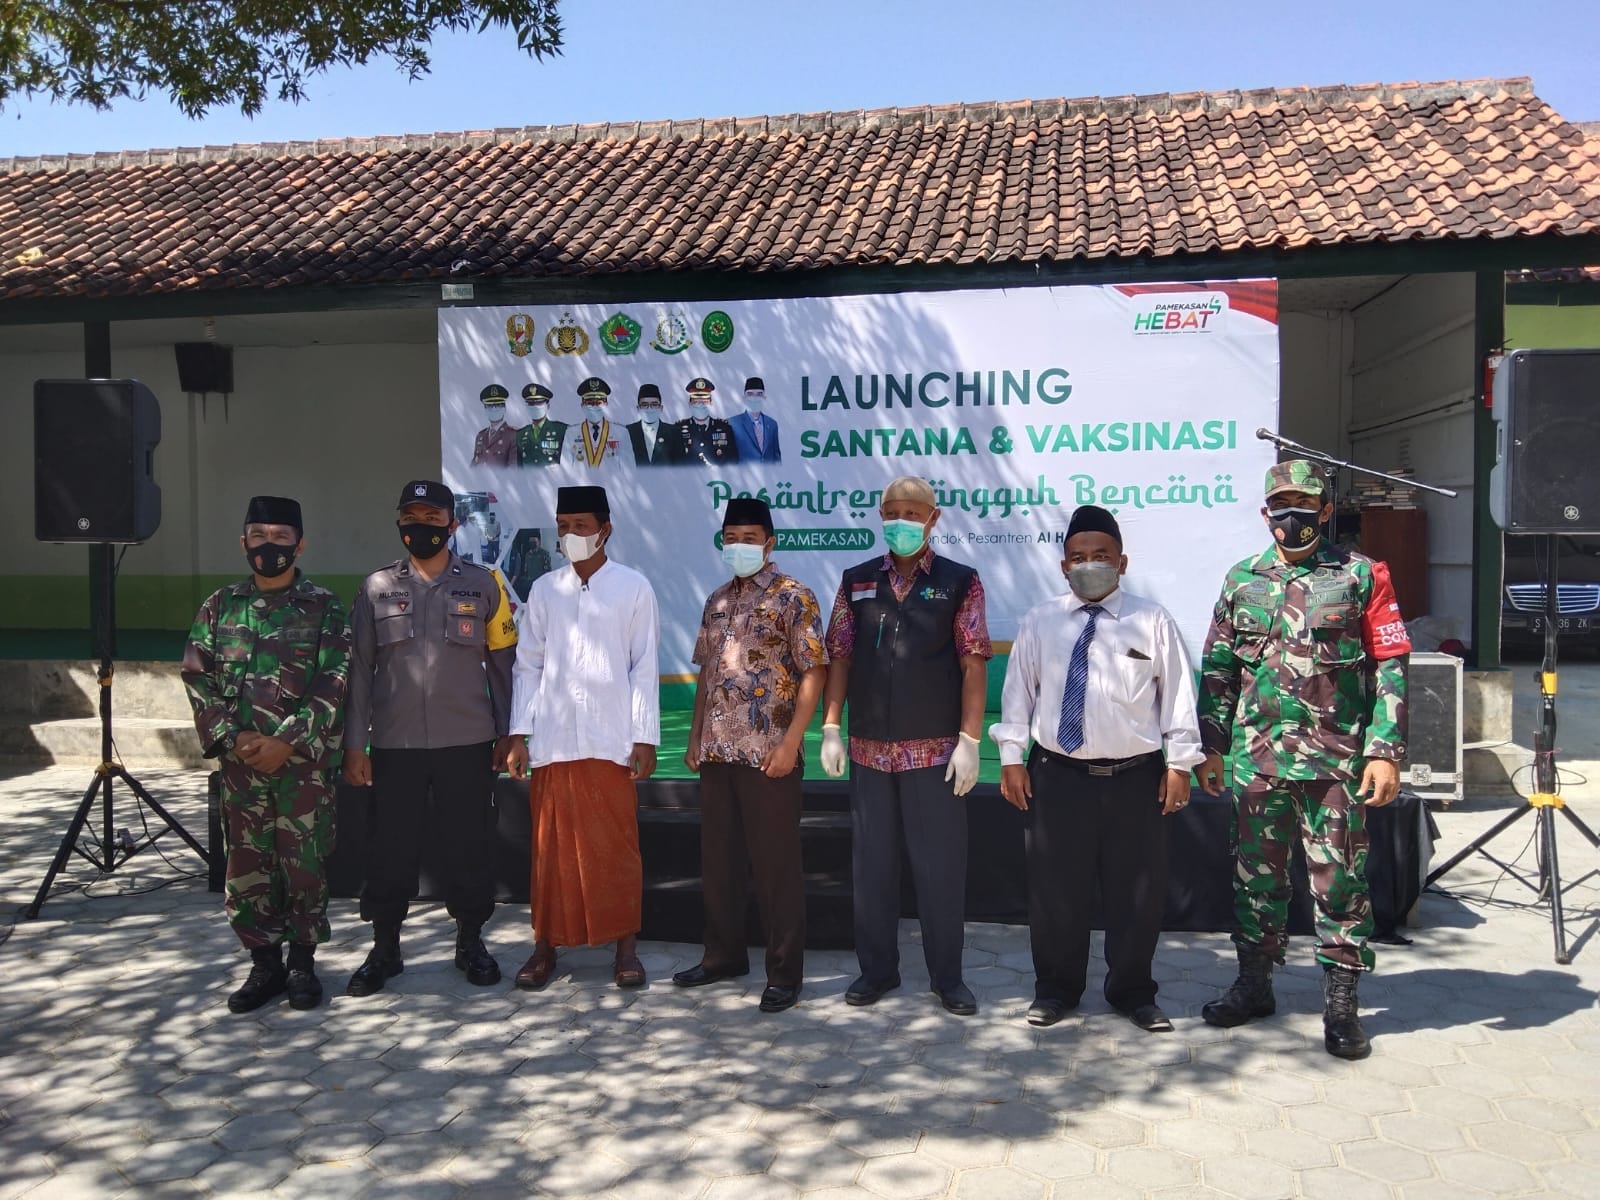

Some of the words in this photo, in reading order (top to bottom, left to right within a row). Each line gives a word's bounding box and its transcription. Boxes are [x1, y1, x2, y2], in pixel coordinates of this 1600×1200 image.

[1155, 303, 1208, 311] PAMEKASAN
[1134, 311, 1214, 330] HEBAT
[801, 368, 1072, 411] LAUNCHING
[800, 427, 977, 459] SANTANA
[988, 426, 1013, 455] &
[1025, 420, 1237, 453] VAKSINASI
[777, 531, 869, 546] PAMEKASAN
[968, 532, 1032, 544] Pesantren
[451, 590, 481, 599] POLRI
